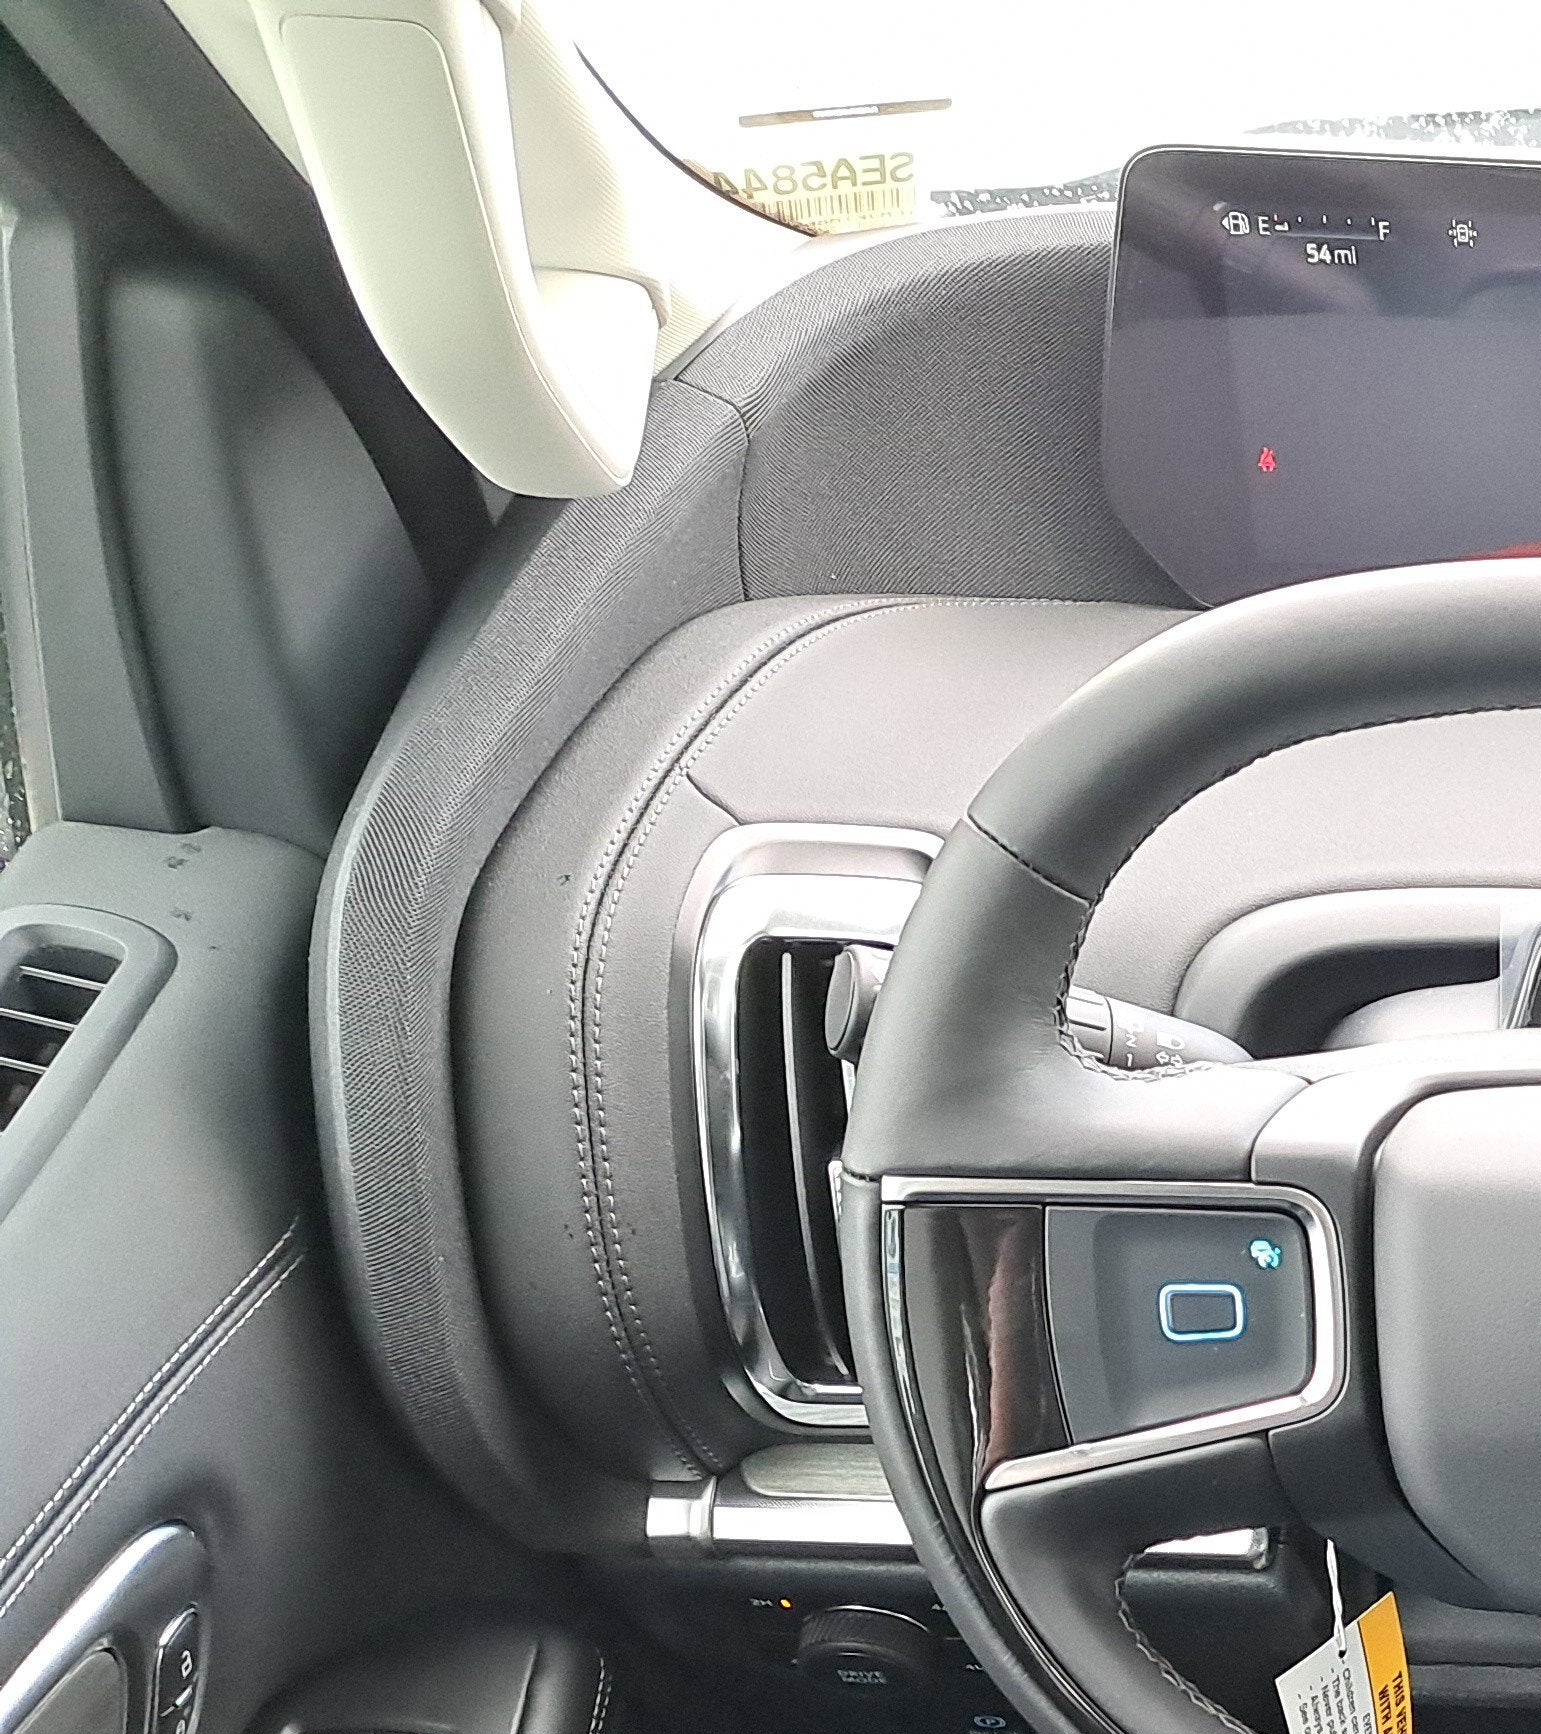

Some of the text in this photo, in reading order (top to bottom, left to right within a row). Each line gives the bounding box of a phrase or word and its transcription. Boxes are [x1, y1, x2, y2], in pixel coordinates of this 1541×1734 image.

[1258, 215, 1271, 236] E
[1378, 221, 1390, 241] F
[1305, 243, 1331, 264] 54
[1392, 1671, 1406, 1707] THIS
[1379, 1684, 1391, 1725] WITH
